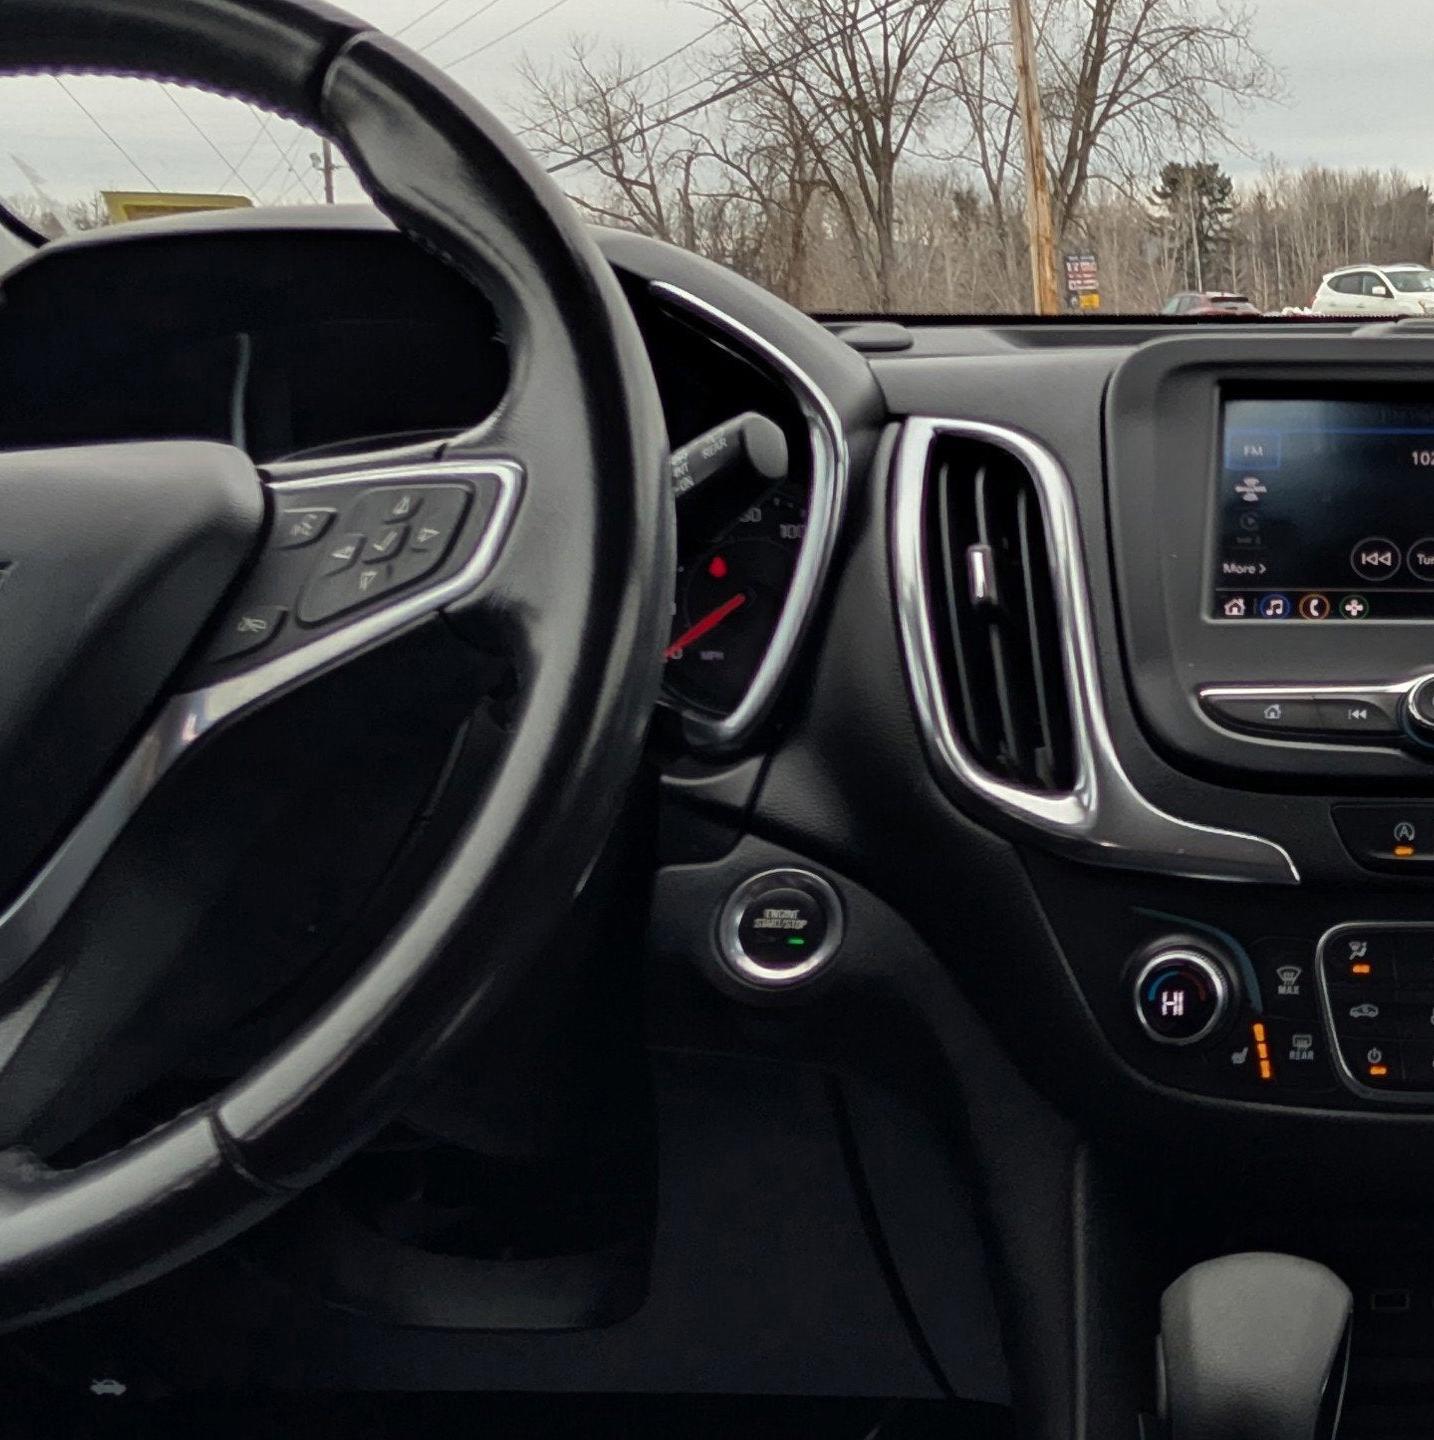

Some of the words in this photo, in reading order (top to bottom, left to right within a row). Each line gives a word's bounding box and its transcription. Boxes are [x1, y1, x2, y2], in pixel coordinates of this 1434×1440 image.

[1244, 445, 1264, 458] FM
[1222, 563, 1256, 575] More
[1161, 990, 1185, 1016] HI
